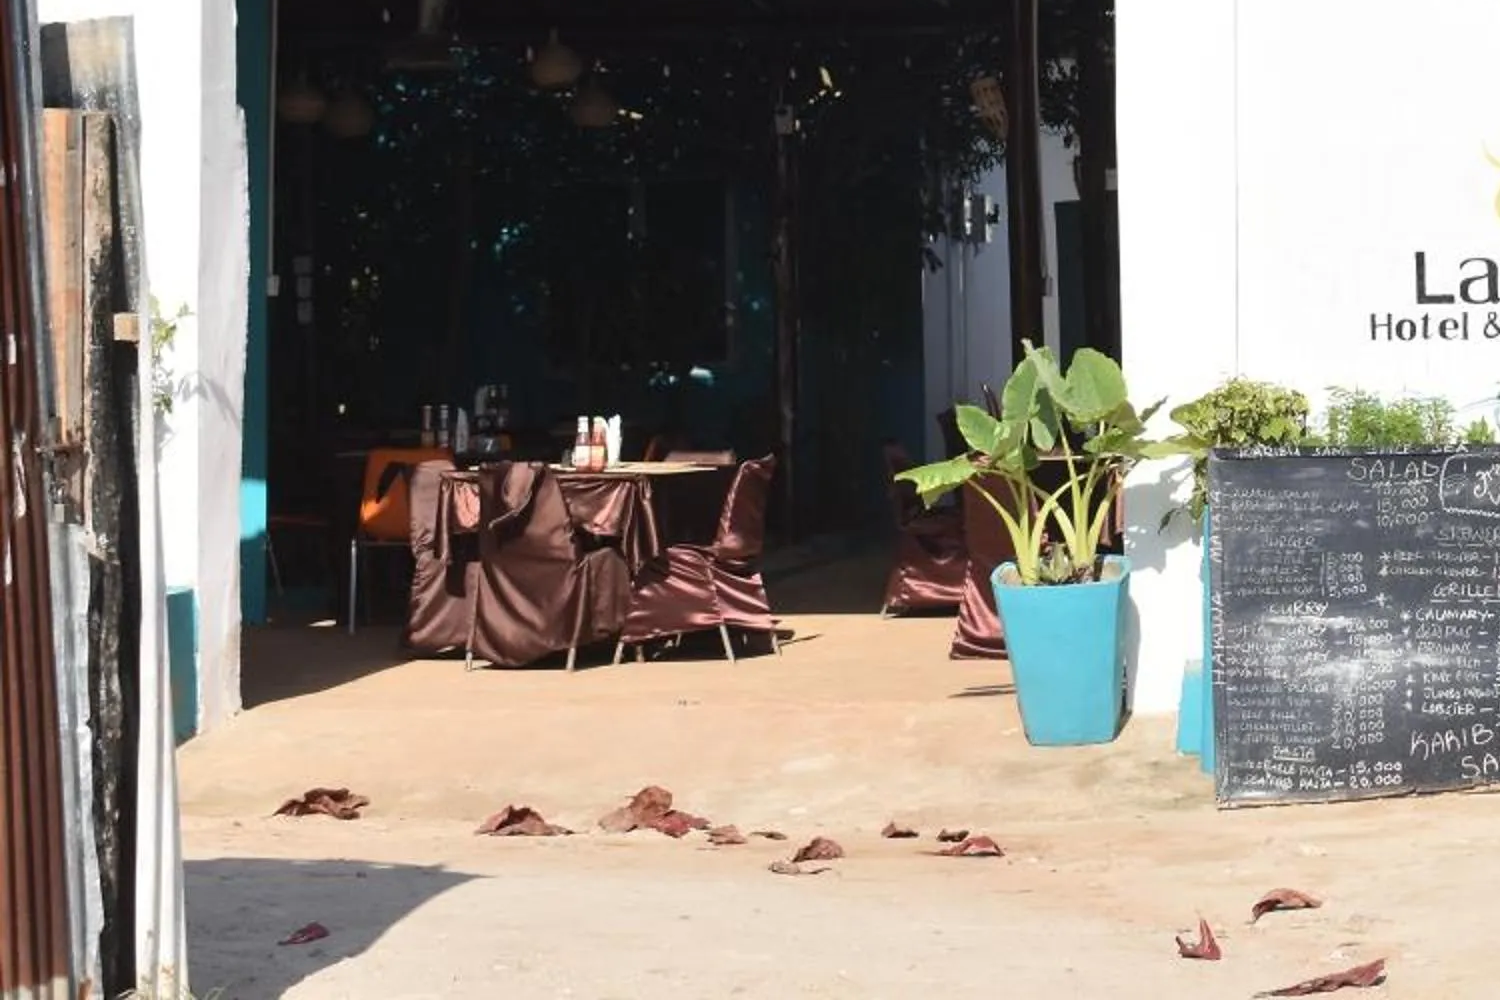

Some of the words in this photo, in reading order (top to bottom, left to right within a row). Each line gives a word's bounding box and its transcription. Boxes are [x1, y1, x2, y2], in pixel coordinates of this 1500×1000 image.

[1370, 311, 1469, 341] Hotel
[1346, 457, 1440, 481] SALAD
[1376, 511, 1430, 527] 10,000
[1350, 759, 1403, 774] 15,000
[1350, 774, 1403, 789] 20,000
